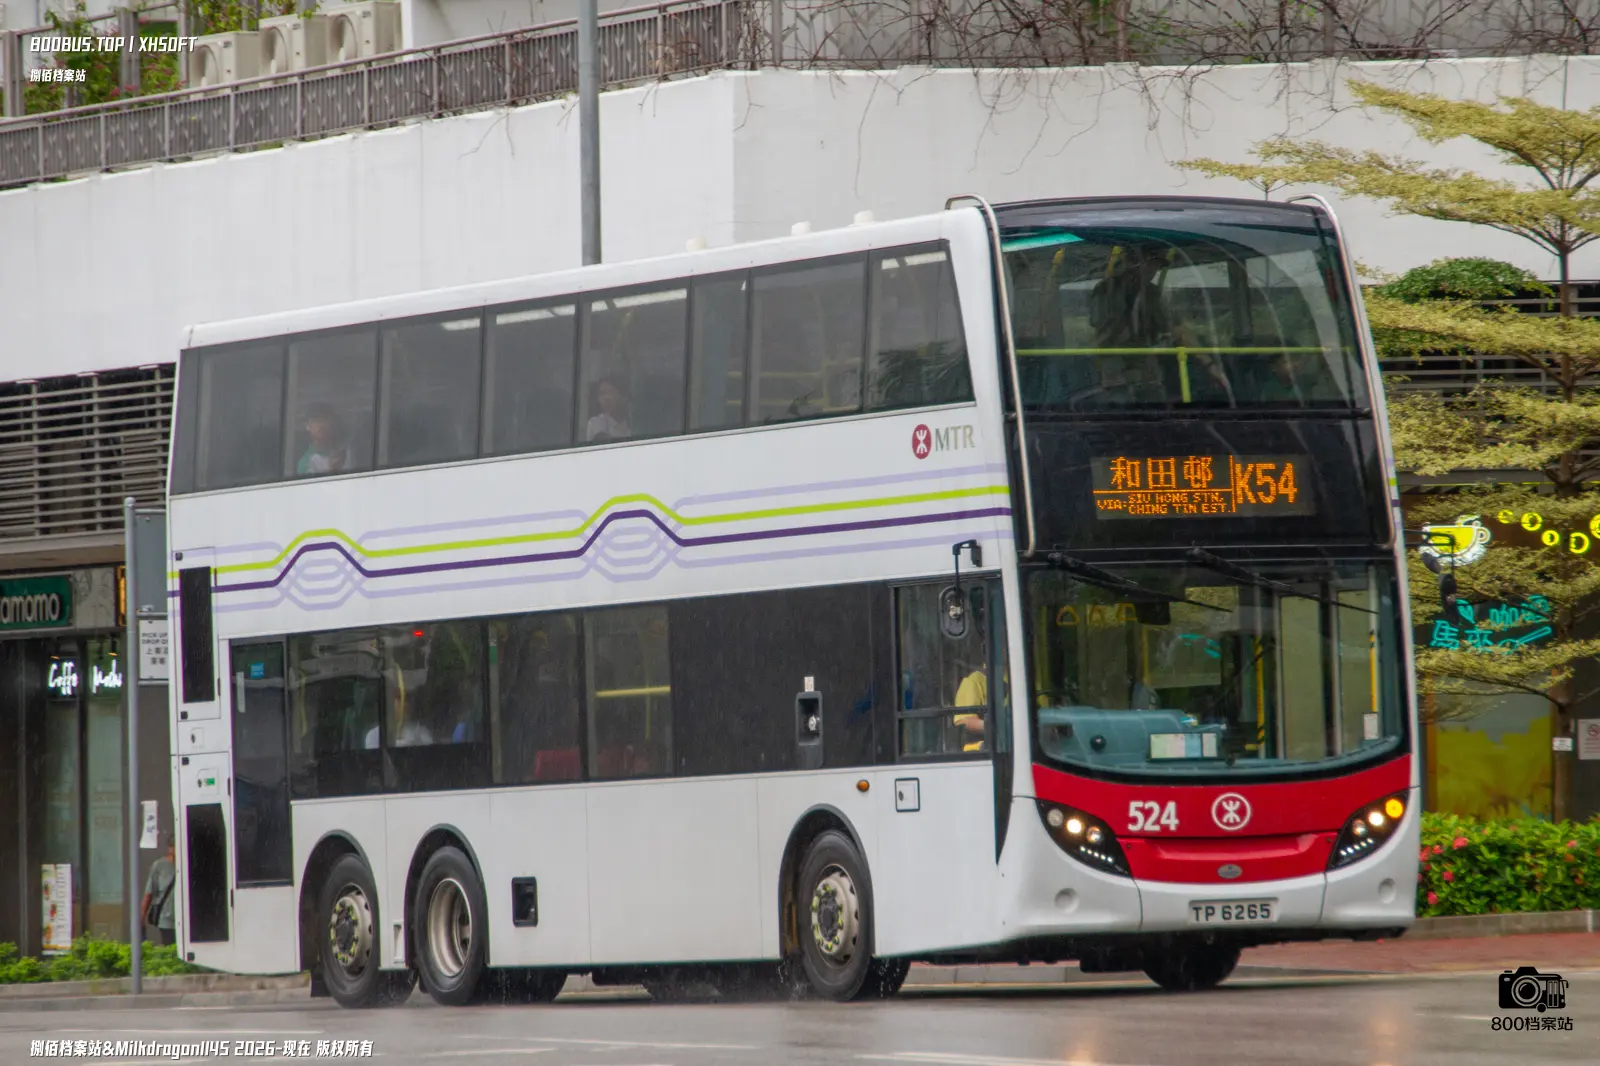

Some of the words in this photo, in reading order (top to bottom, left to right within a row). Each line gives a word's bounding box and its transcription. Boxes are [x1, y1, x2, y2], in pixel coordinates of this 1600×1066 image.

[934, 424, 976, 452] MTR
[1110, 456, 1213, 489] 和田邨
[1235, 463, 1297, 504] K54
[1128, 493, 1151, 503] SIU
[1155, 493, 1188, 503] HONG
[1128, 504, 1168, 514] CHING
[1172, 504, 1197, 513] TIN
[1127, 800, 1180, 832] 524
[1191, 904, 1216, 922] TP
[1221, 903, 1271, 921] 6265
